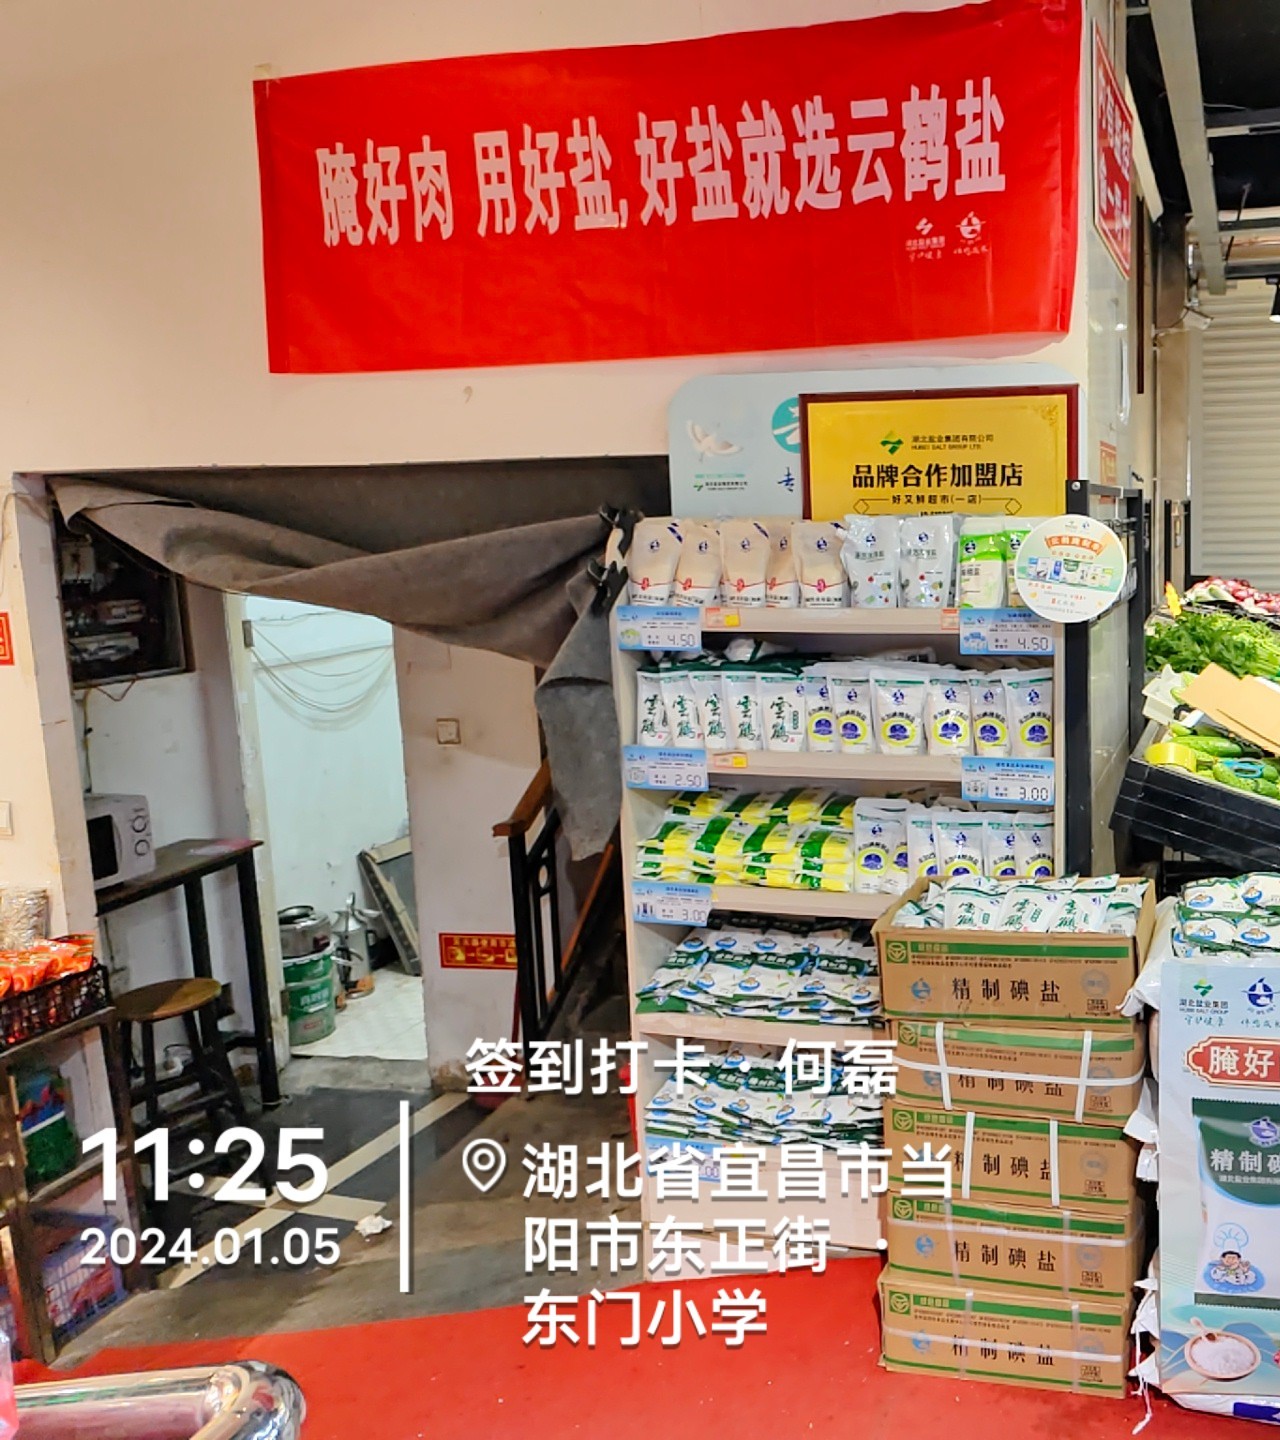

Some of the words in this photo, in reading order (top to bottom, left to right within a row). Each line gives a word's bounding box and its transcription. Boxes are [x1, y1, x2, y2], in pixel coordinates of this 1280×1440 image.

[317, 137, 452, 250] 腌好肉
[473, 76, 1006, 239] 用好盐,好盐就选云鹤盐
[853, 462, 1023, 488] 品牌合作加盟店
[667, 633, 695, 647] 4.50
[1018, 637, 1049, 650] 4.50
[675, 773, 702, 788] 2.50
[1019, 786, 1049, 801] 3.00
[682, 908, 707, 923] 3.00
[952, 977, 1061, 1003] 精制碘盐
[954, 1239, 1056, 1272] 精制碘盐
